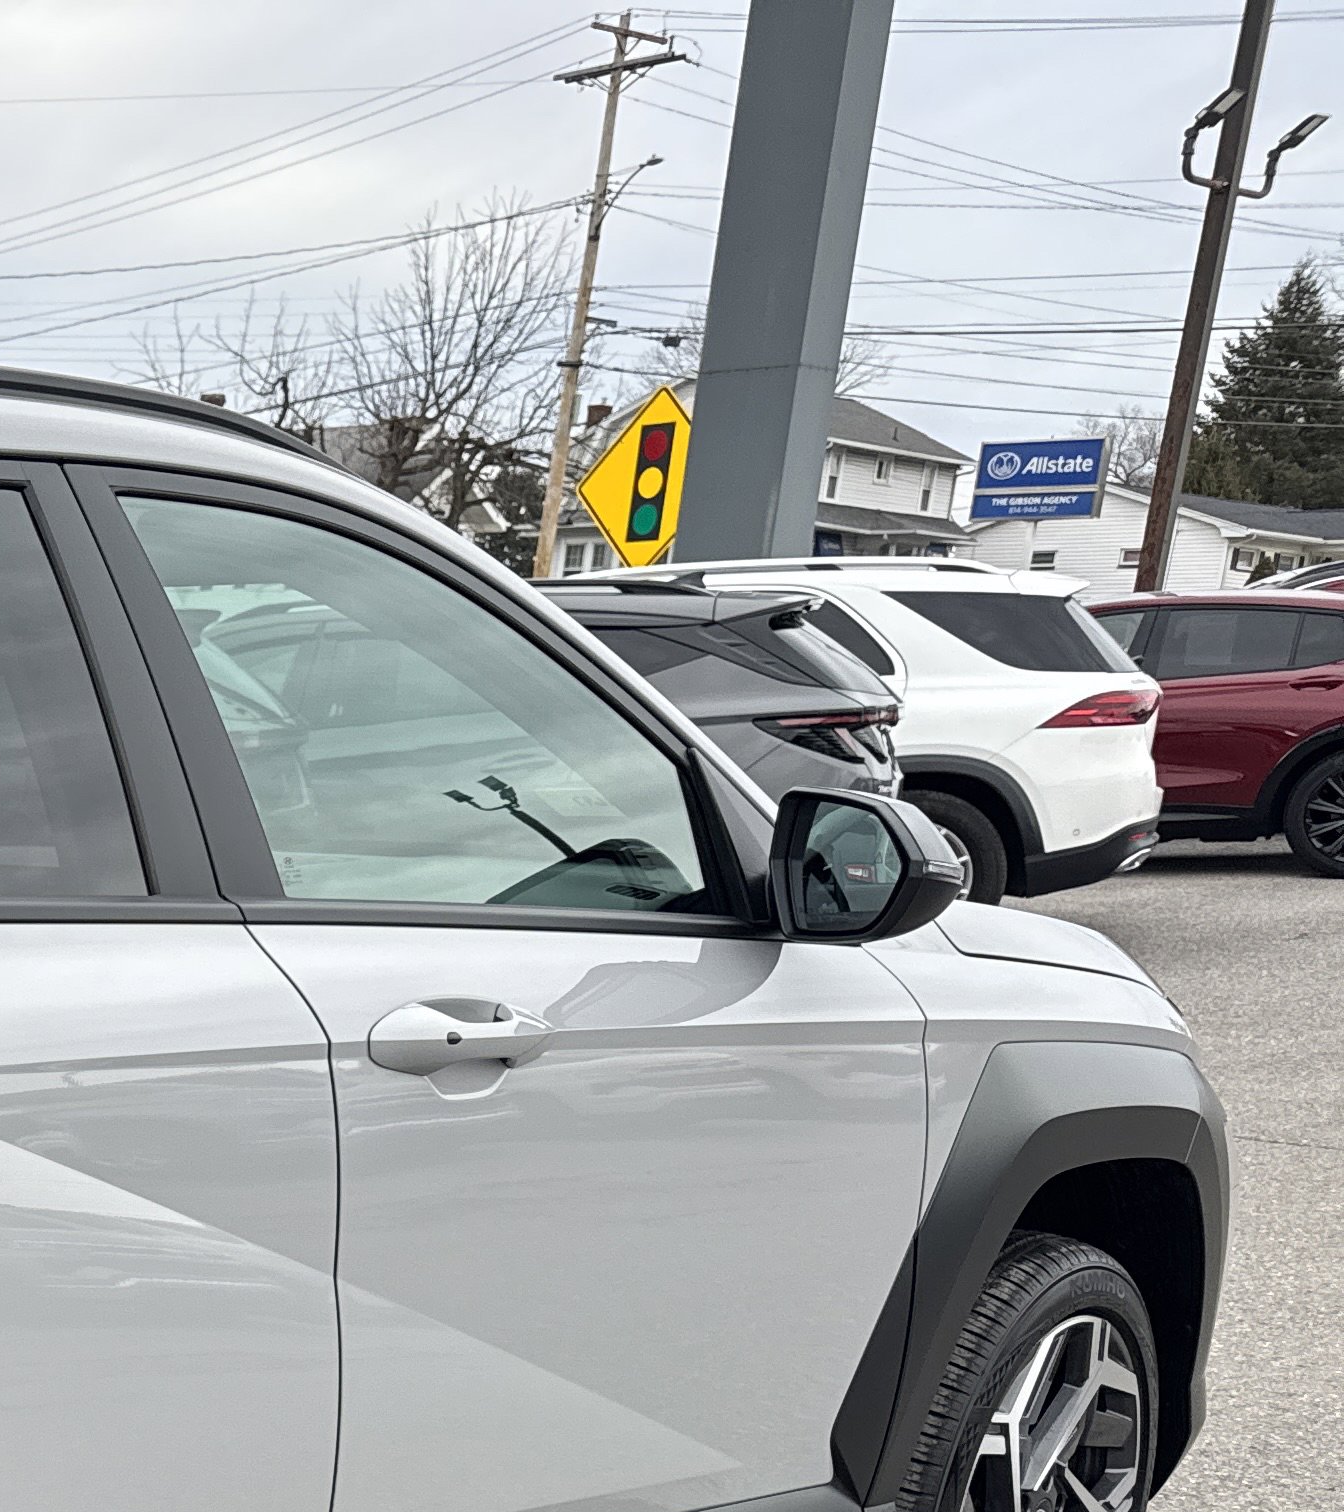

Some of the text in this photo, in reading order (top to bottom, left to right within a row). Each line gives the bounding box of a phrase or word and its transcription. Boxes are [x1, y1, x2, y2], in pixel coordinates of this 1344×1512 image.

[1021, 455, 1094, 475] Allstate
[992, 495, 1079, 507] THE GIBSON AGENCY
[1070, 1271, 1126, 1299] KUMHO
